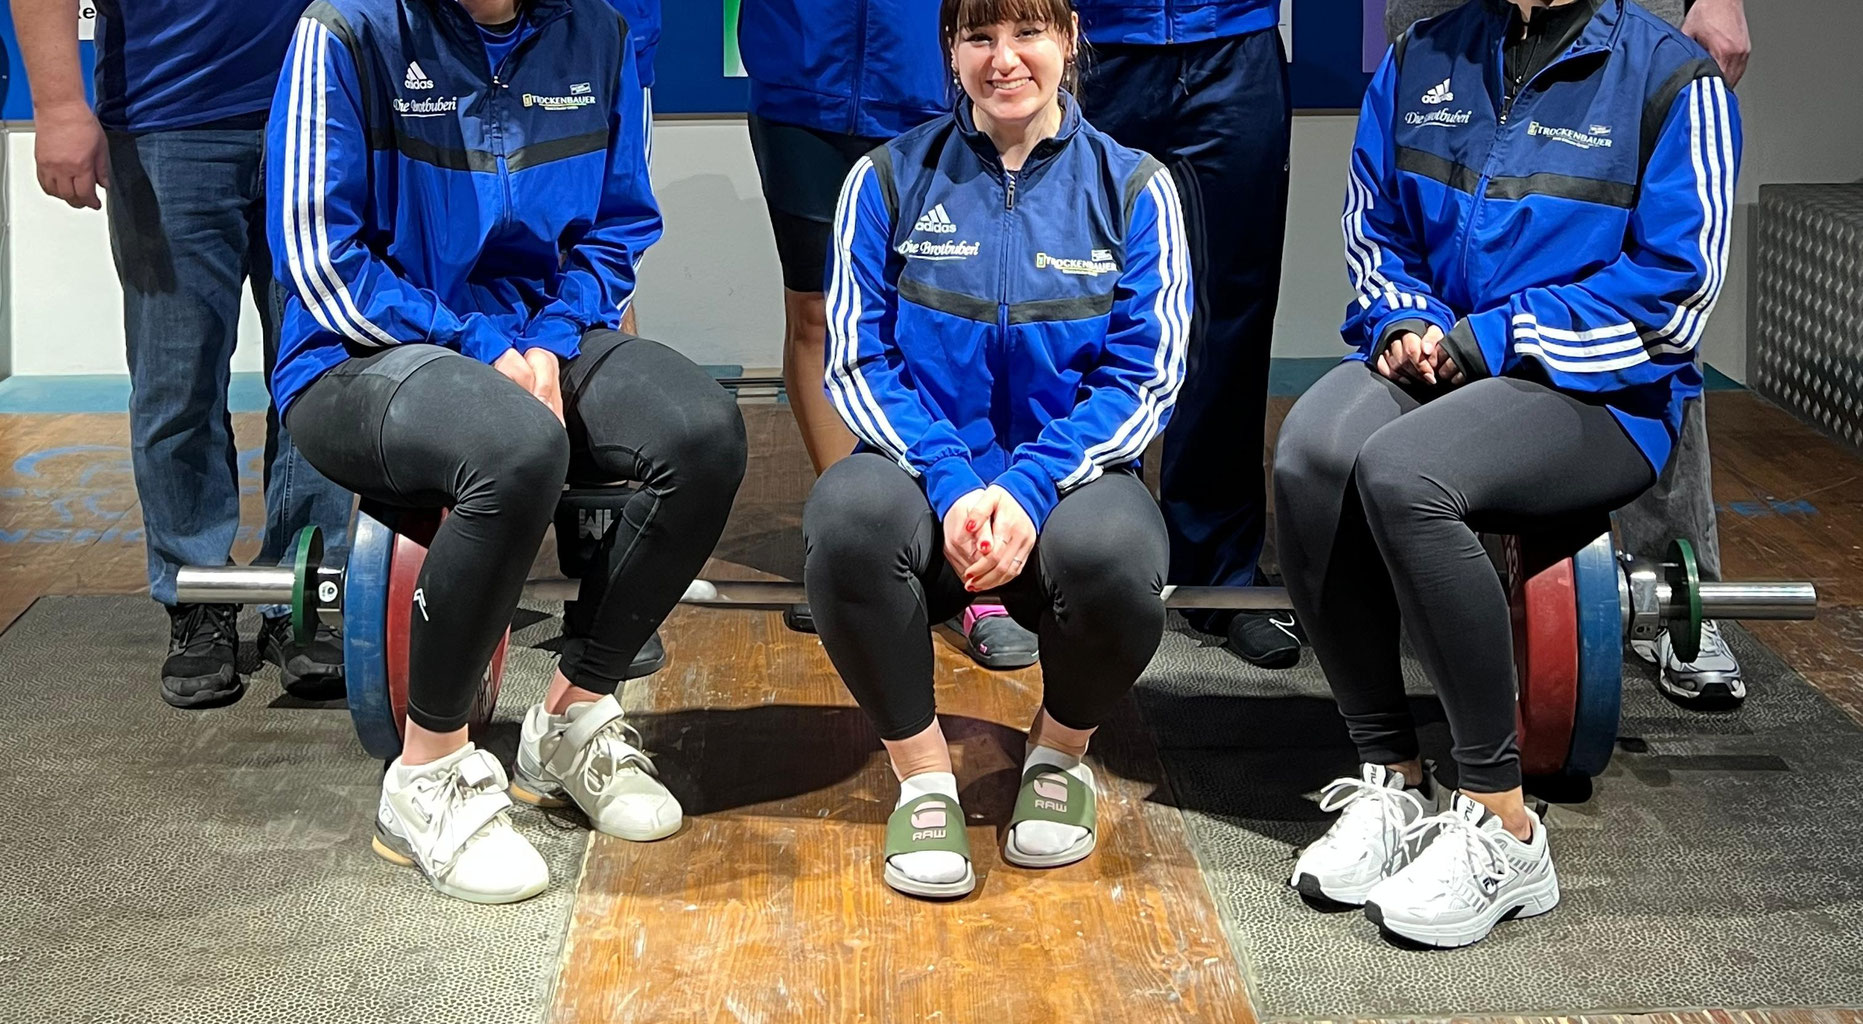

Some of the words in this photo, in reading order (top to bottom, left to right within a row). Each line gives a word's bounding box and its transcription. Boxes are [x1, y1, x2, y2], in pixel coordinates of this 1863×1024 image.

[393, 98, 410, 112] Die
[1537, 125, 1613, 148] TROCKENBAUER
[915, 221, 957, 234] adidas
[898, 239, 918, 254] Die
[920, 239, 980, 256] Brotbuben
[1046, 254, 1117, 272] TROCKENBAUER
[1034, 799, 1067, 813] RAW
[912, 829, 947, 841] RAW
